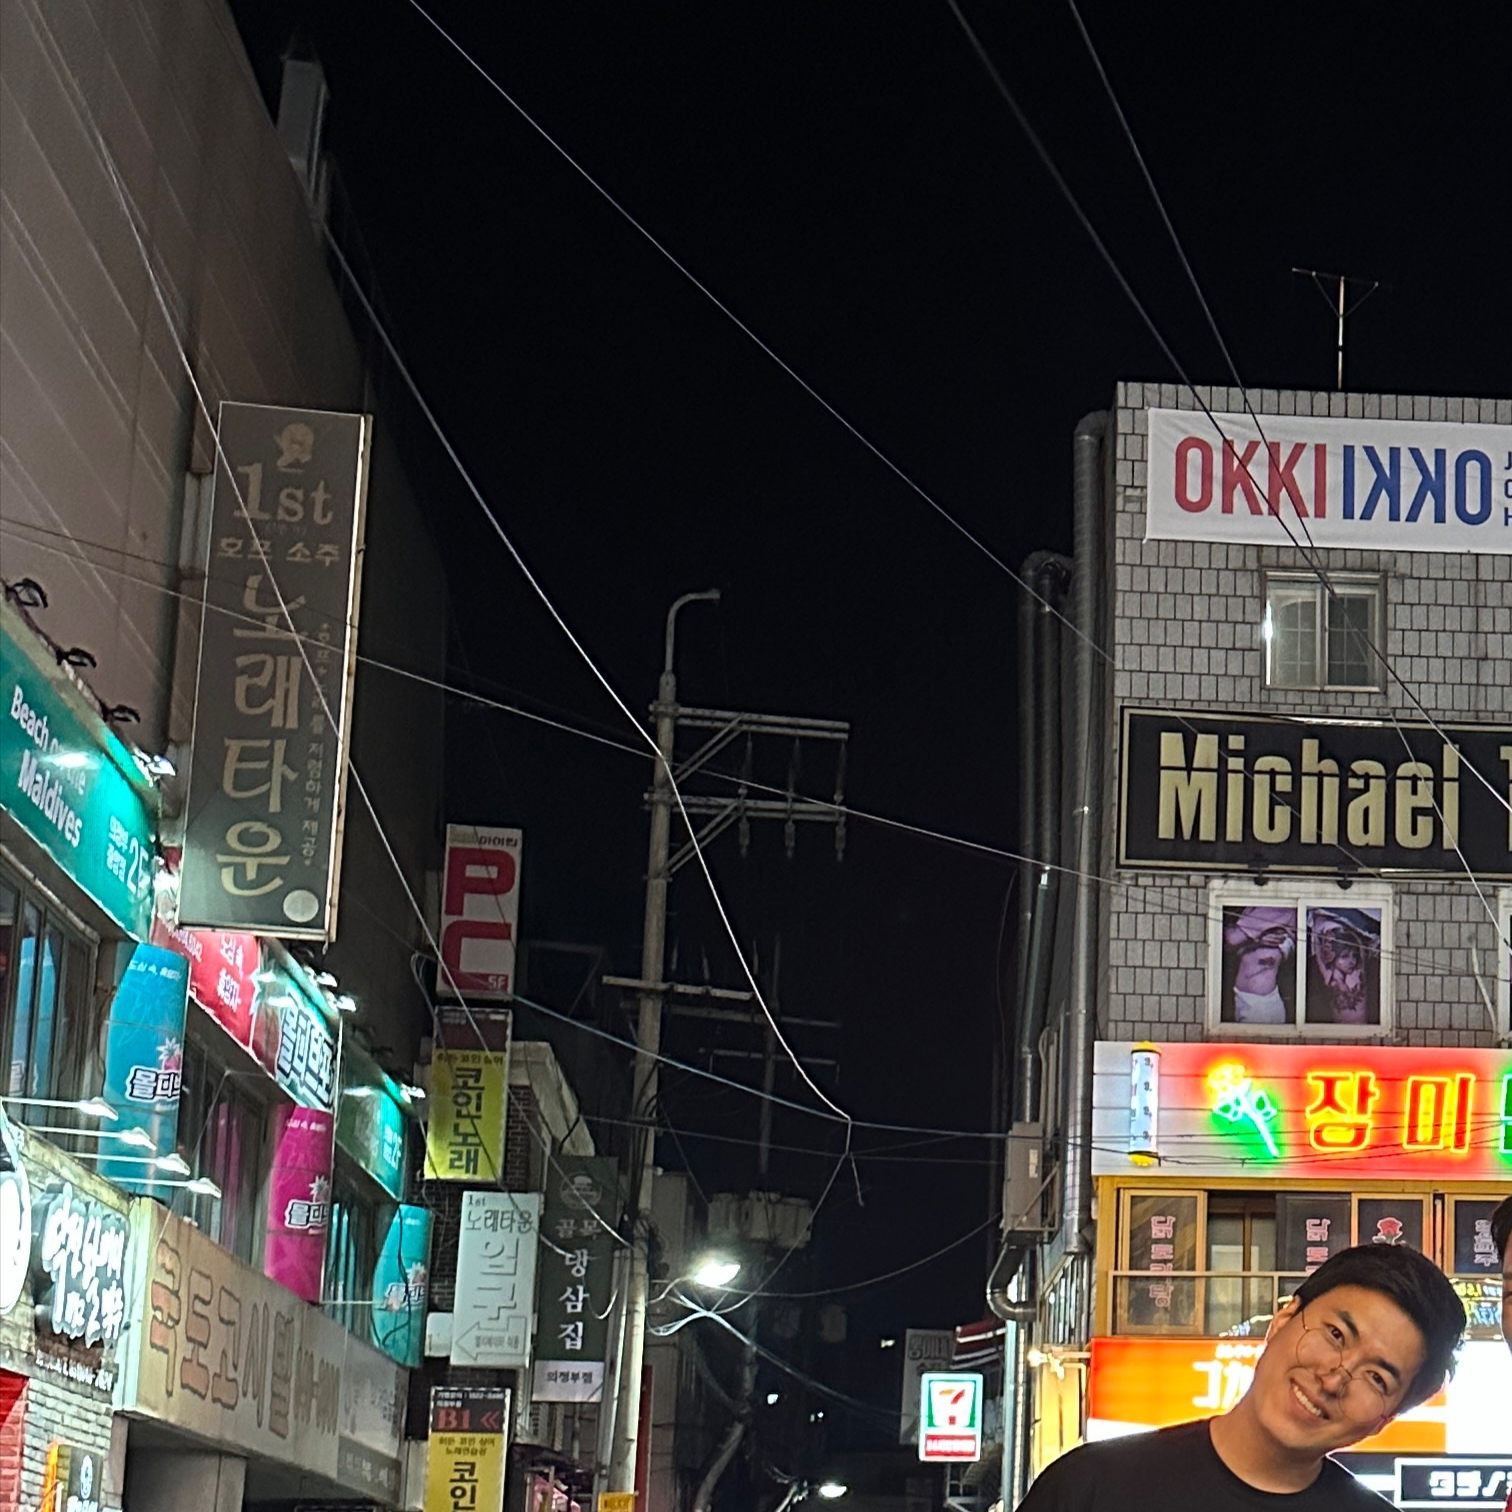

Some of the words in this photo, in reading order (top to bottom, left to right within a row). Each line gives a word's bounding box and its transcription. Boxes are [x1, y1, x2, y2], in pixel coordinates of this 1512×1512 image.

[233, 462, 334, 526] 1st
[1175, 436, 1327, 519] OKKI
[286, 542, 340, 567] 소주
[11, 685, 50, 750] Beach
[215, 573, 307, 897] 노래타운
[18, 748, 83, 850] Maldives
[1158, 731, 1460, 851] Michael
[449, 1067, 485, 1176] 코인노래
[465, 1209, 534, 1234] 노래타운
[547, 1370, 594, 1384] 의정부점
[437, 1408, 471, 1430] B1
